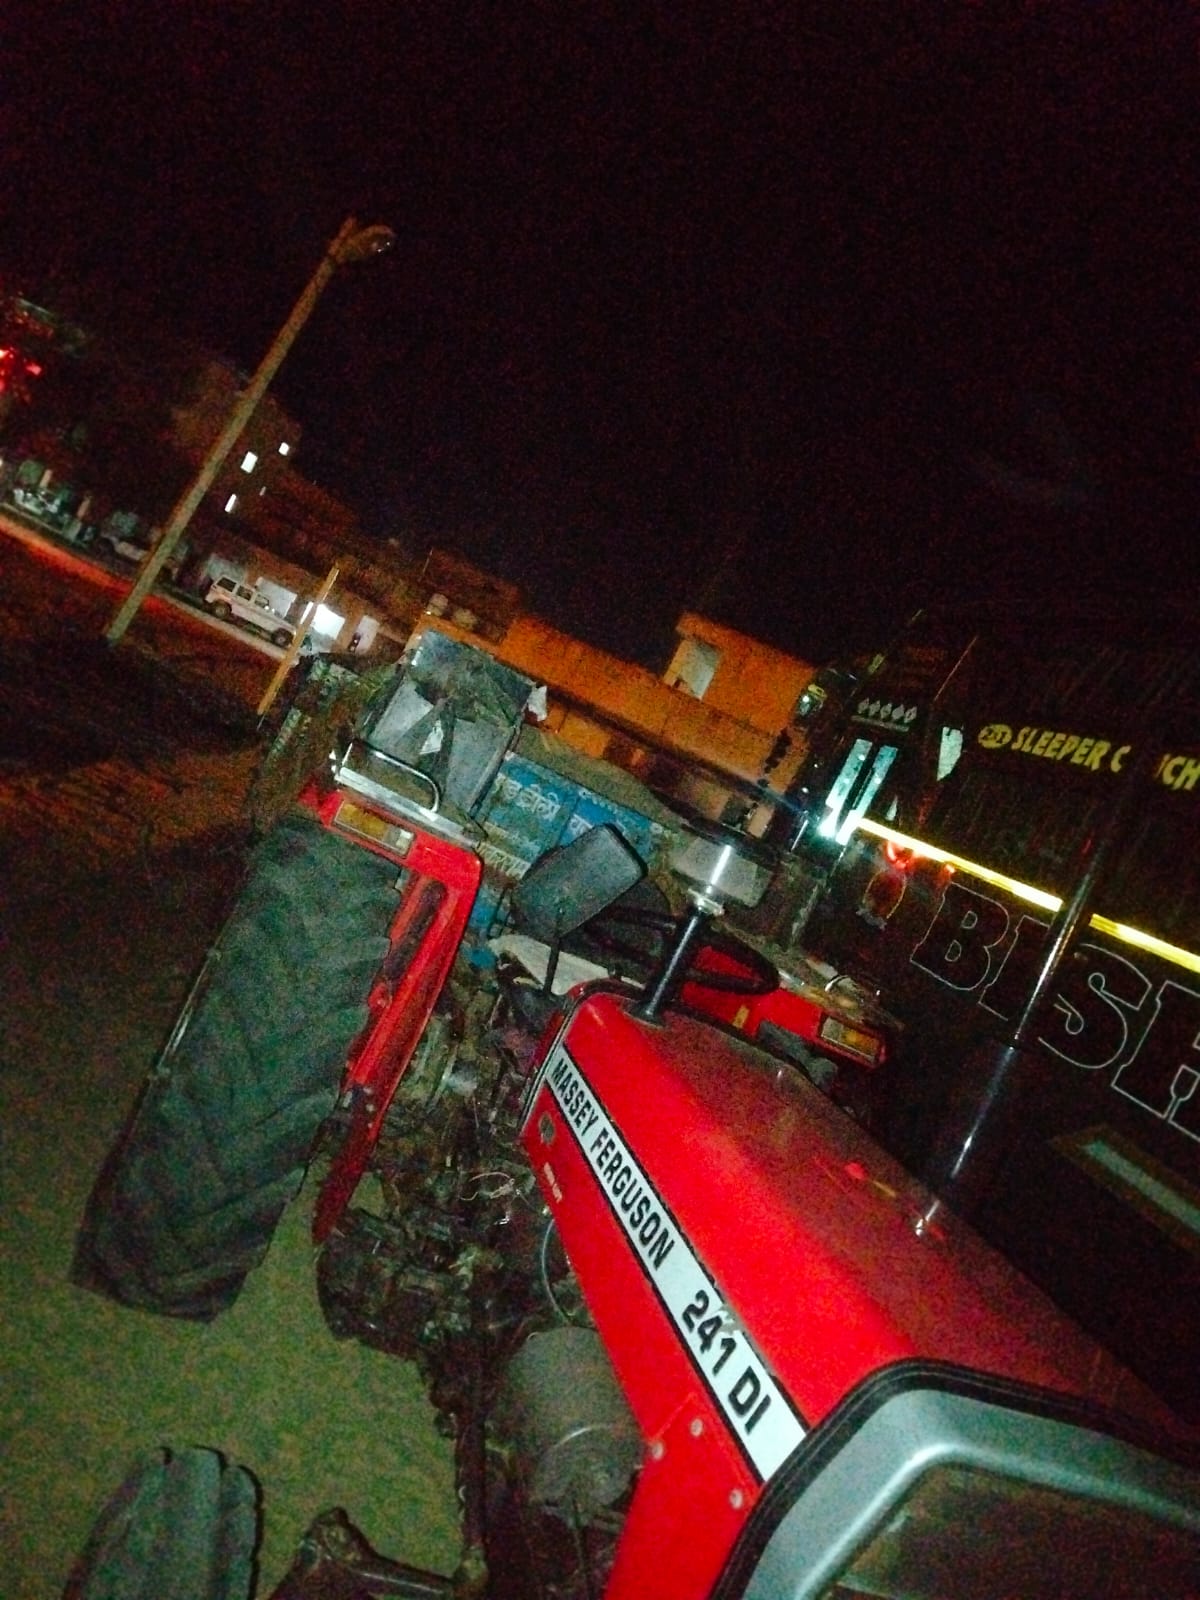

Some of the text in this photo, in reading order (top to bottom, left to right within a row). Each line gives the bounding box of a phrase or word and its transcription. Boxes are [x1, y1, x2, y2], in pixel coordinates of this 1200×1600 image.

[1011, 726, 1111, 771] SLEEPER
[552, 1058, 771, 1434] MASSEY FERGUSON 241 DI
